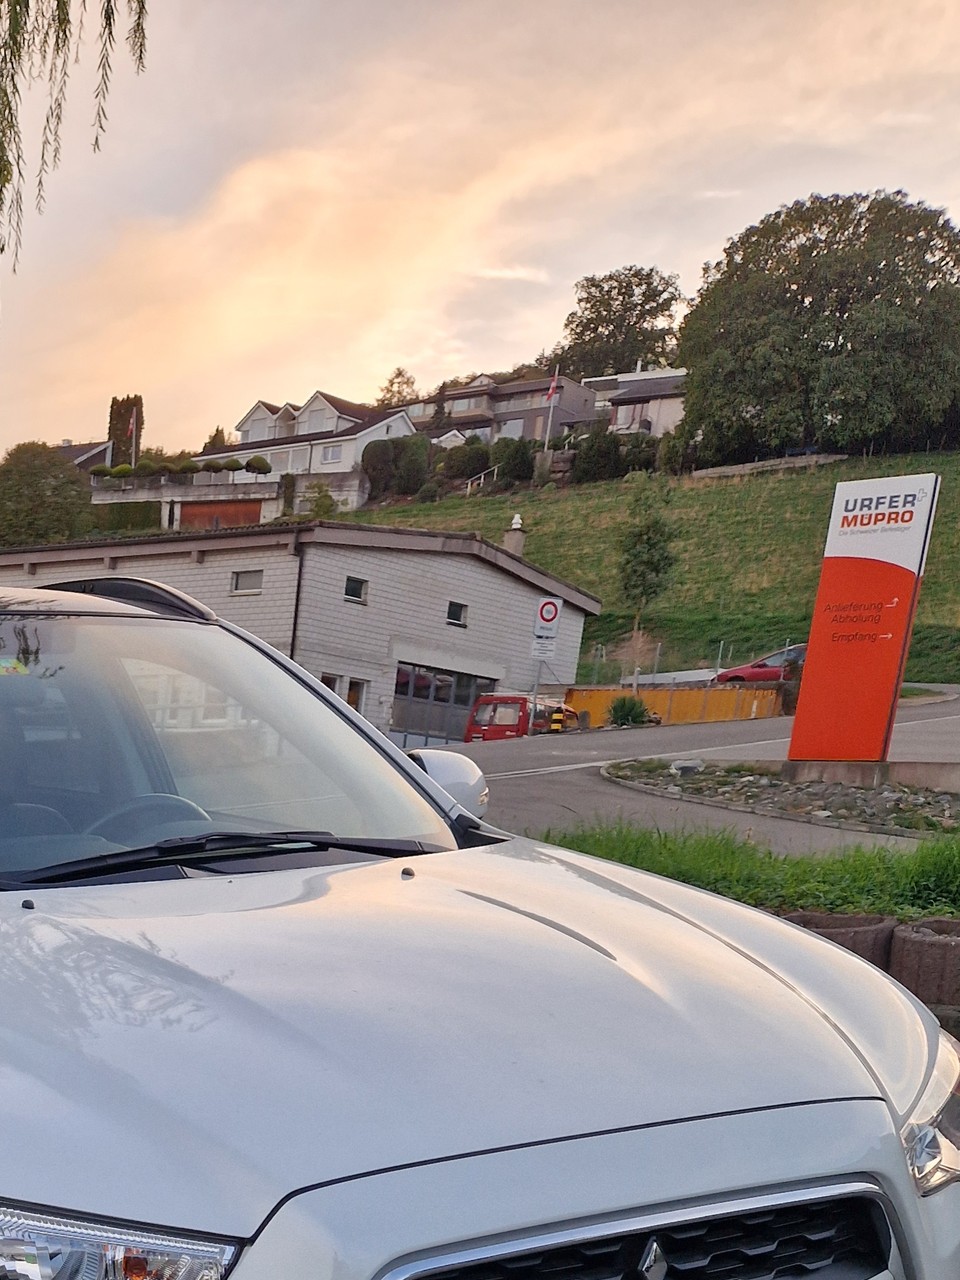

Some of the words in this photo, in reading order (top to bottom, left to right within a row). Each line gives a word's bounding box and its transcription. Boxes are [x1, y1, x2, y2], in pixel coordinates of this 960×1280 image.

[844, 493, 917, 513] URFER
[840, 510, 914, 528] MÜPRO
[824, 602, 883, 612] Anlieferung
[831, 614, 881, 624] Abholung
[831, 632, 877, 642] Empfang
